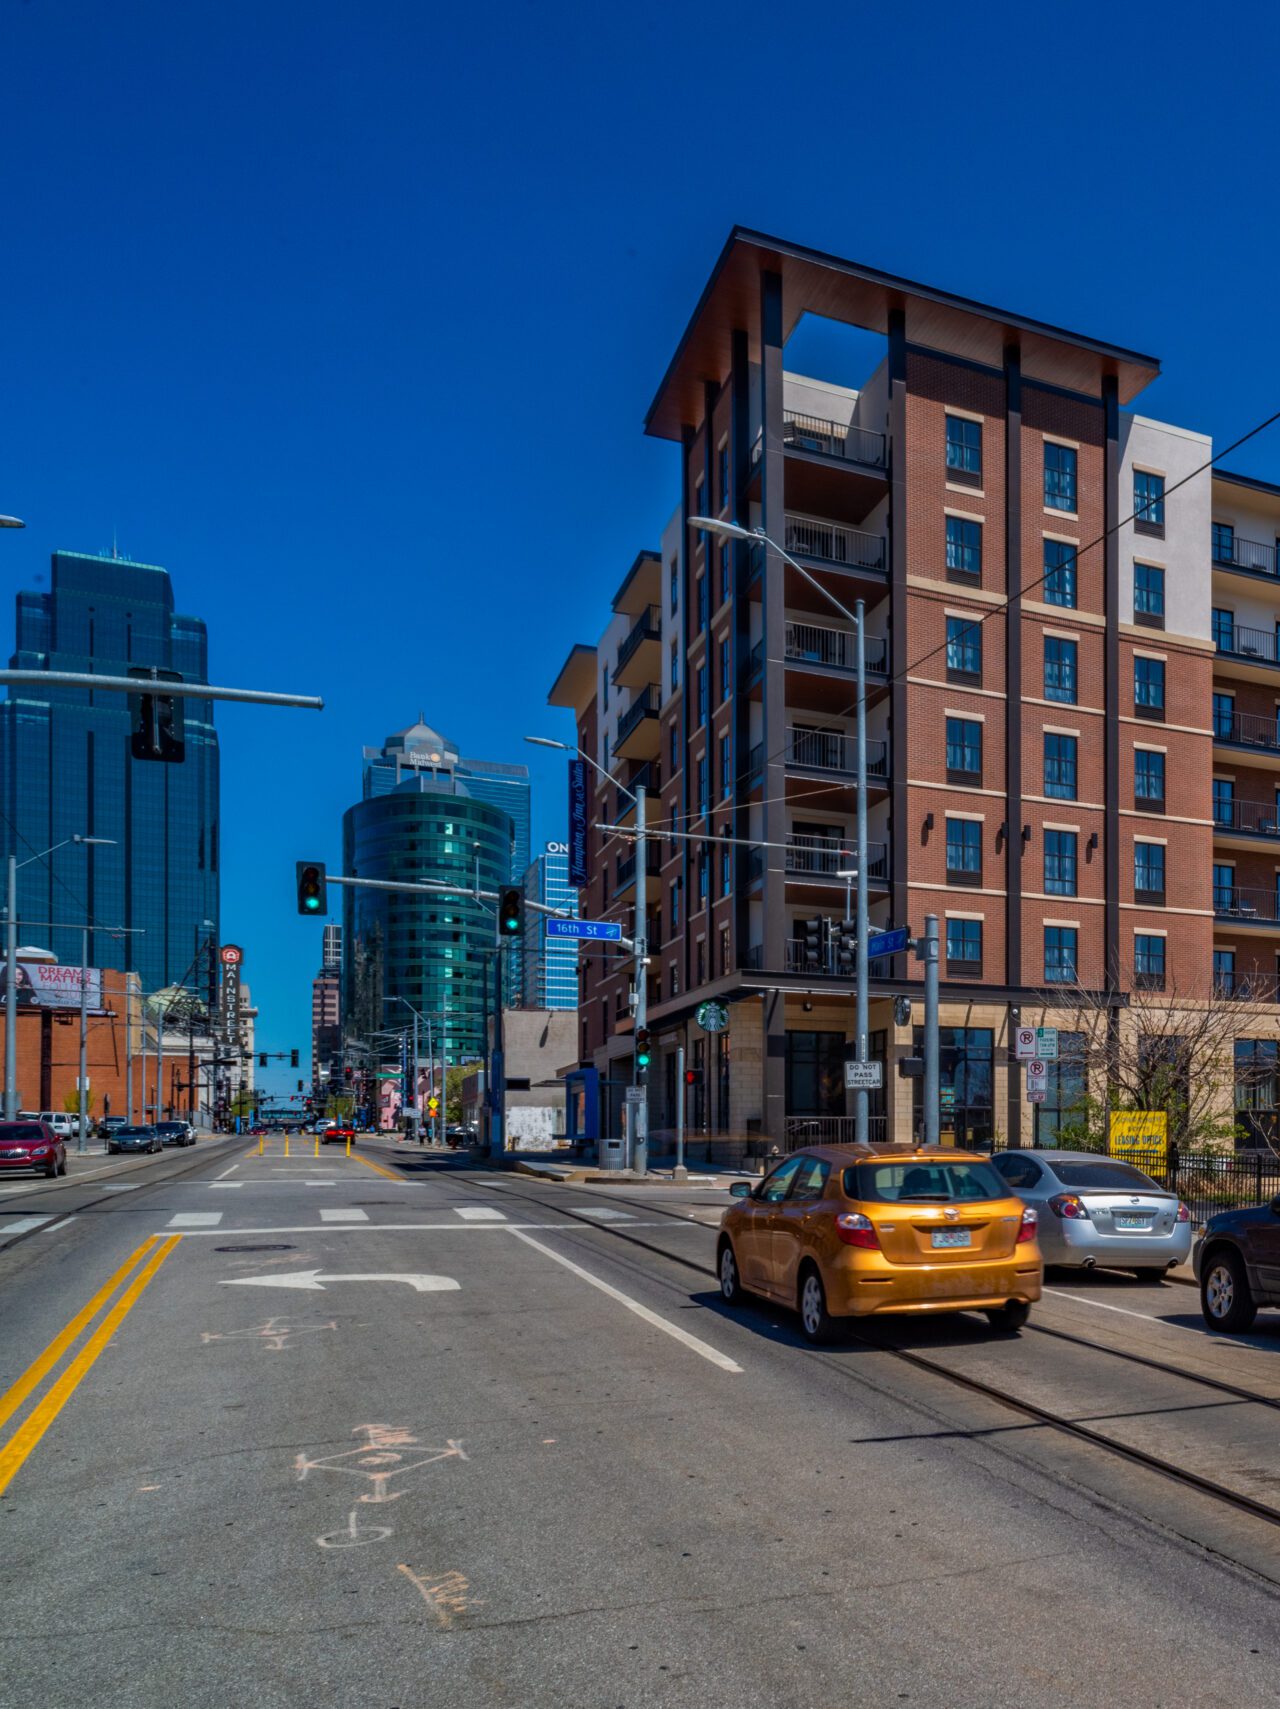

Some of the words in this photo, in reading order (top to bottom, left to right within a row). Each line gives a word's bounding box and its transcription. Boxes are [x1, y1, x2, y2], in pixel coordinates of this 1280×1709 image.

[572, 763, 585, 790] Suites
[571, 825, 586, 883] Hampton
[556, 923, 580, 934] 16th
[586, 924, 598, 936] St
